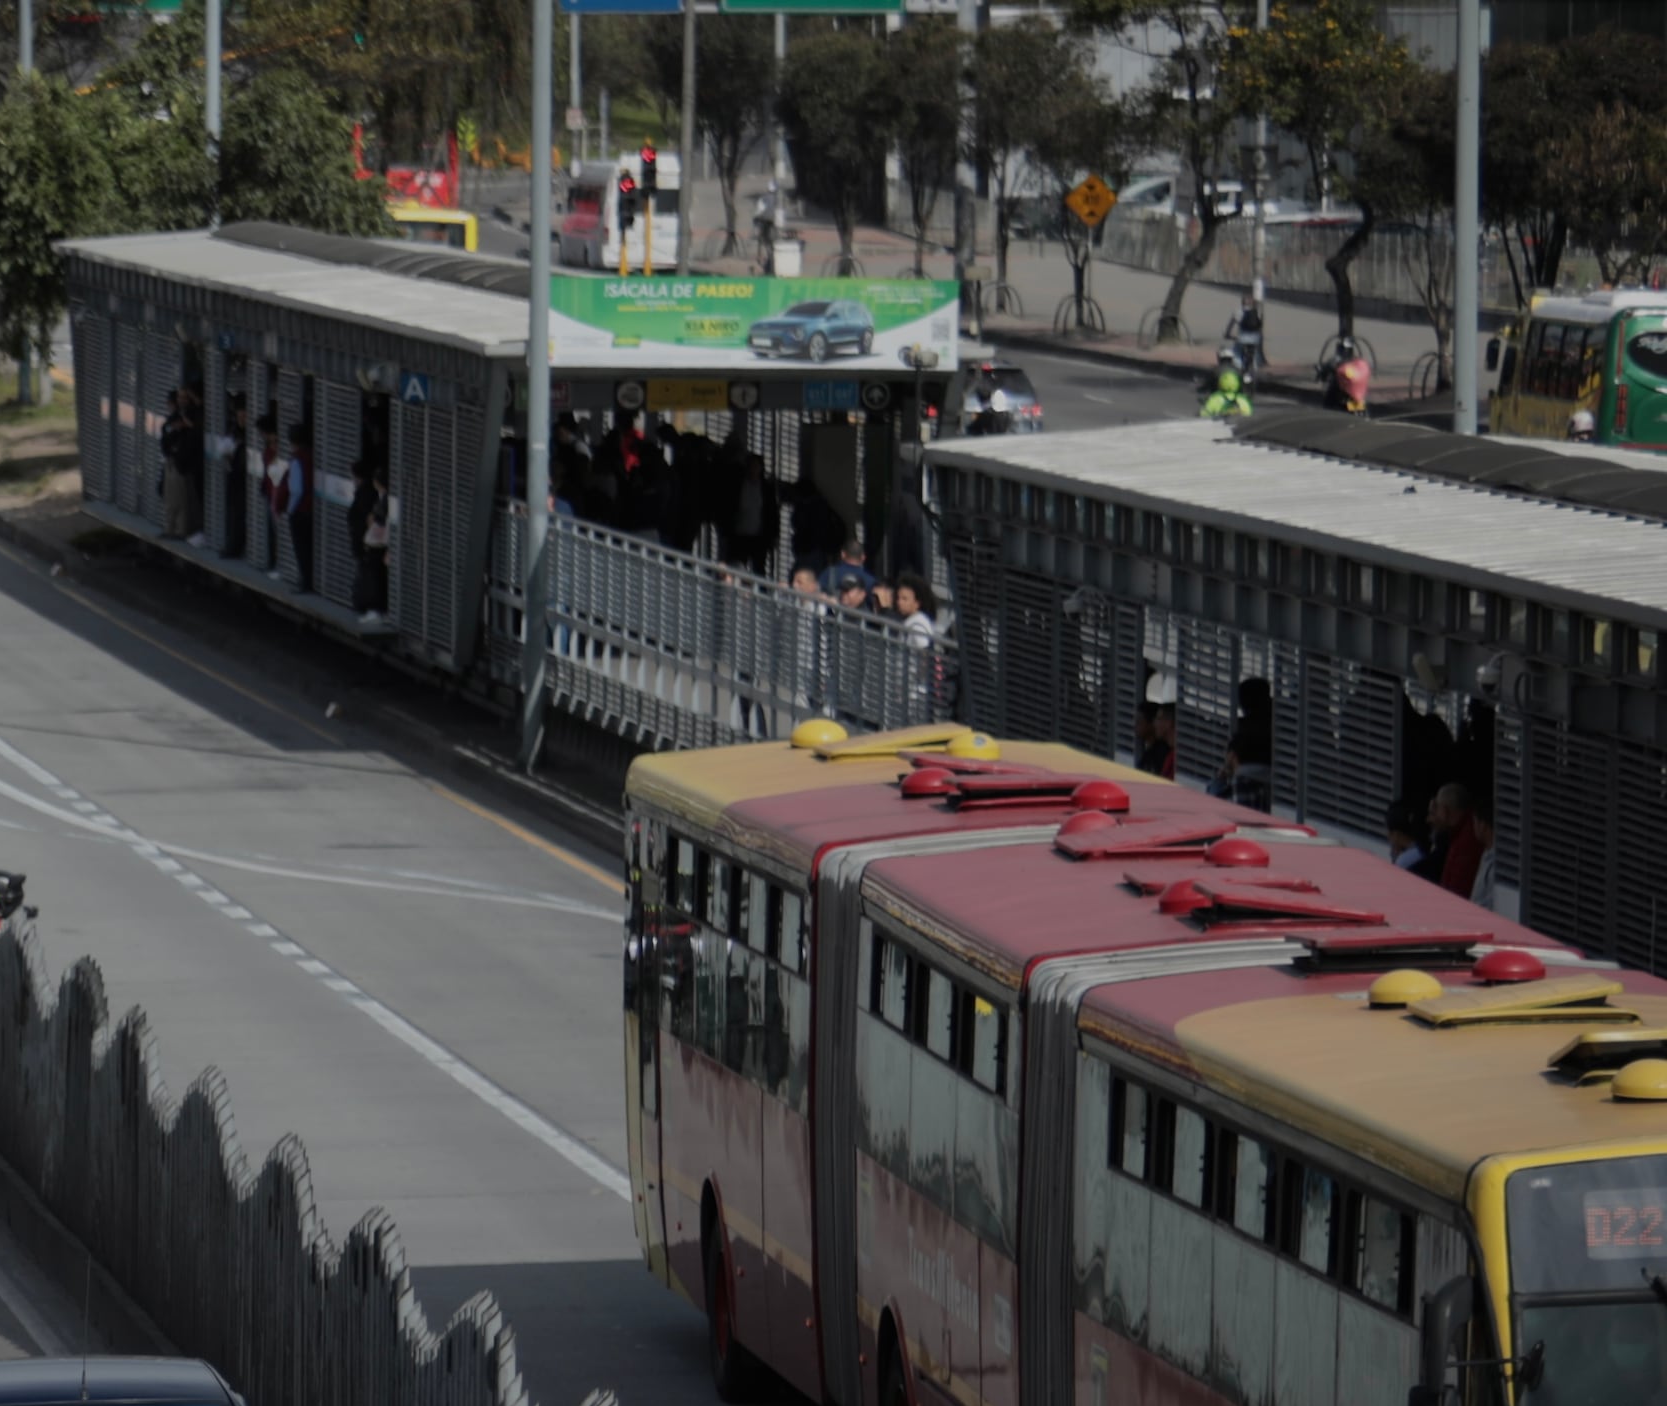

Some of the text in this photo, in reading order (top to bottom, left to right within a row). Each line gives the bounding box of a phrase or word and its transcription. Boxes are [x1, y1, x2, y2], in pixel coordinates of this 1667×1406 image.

[672, 283, 693, 298] DE
[404, 377, 426, 401] A
[1586, 1206, 1663, 1248] D22
